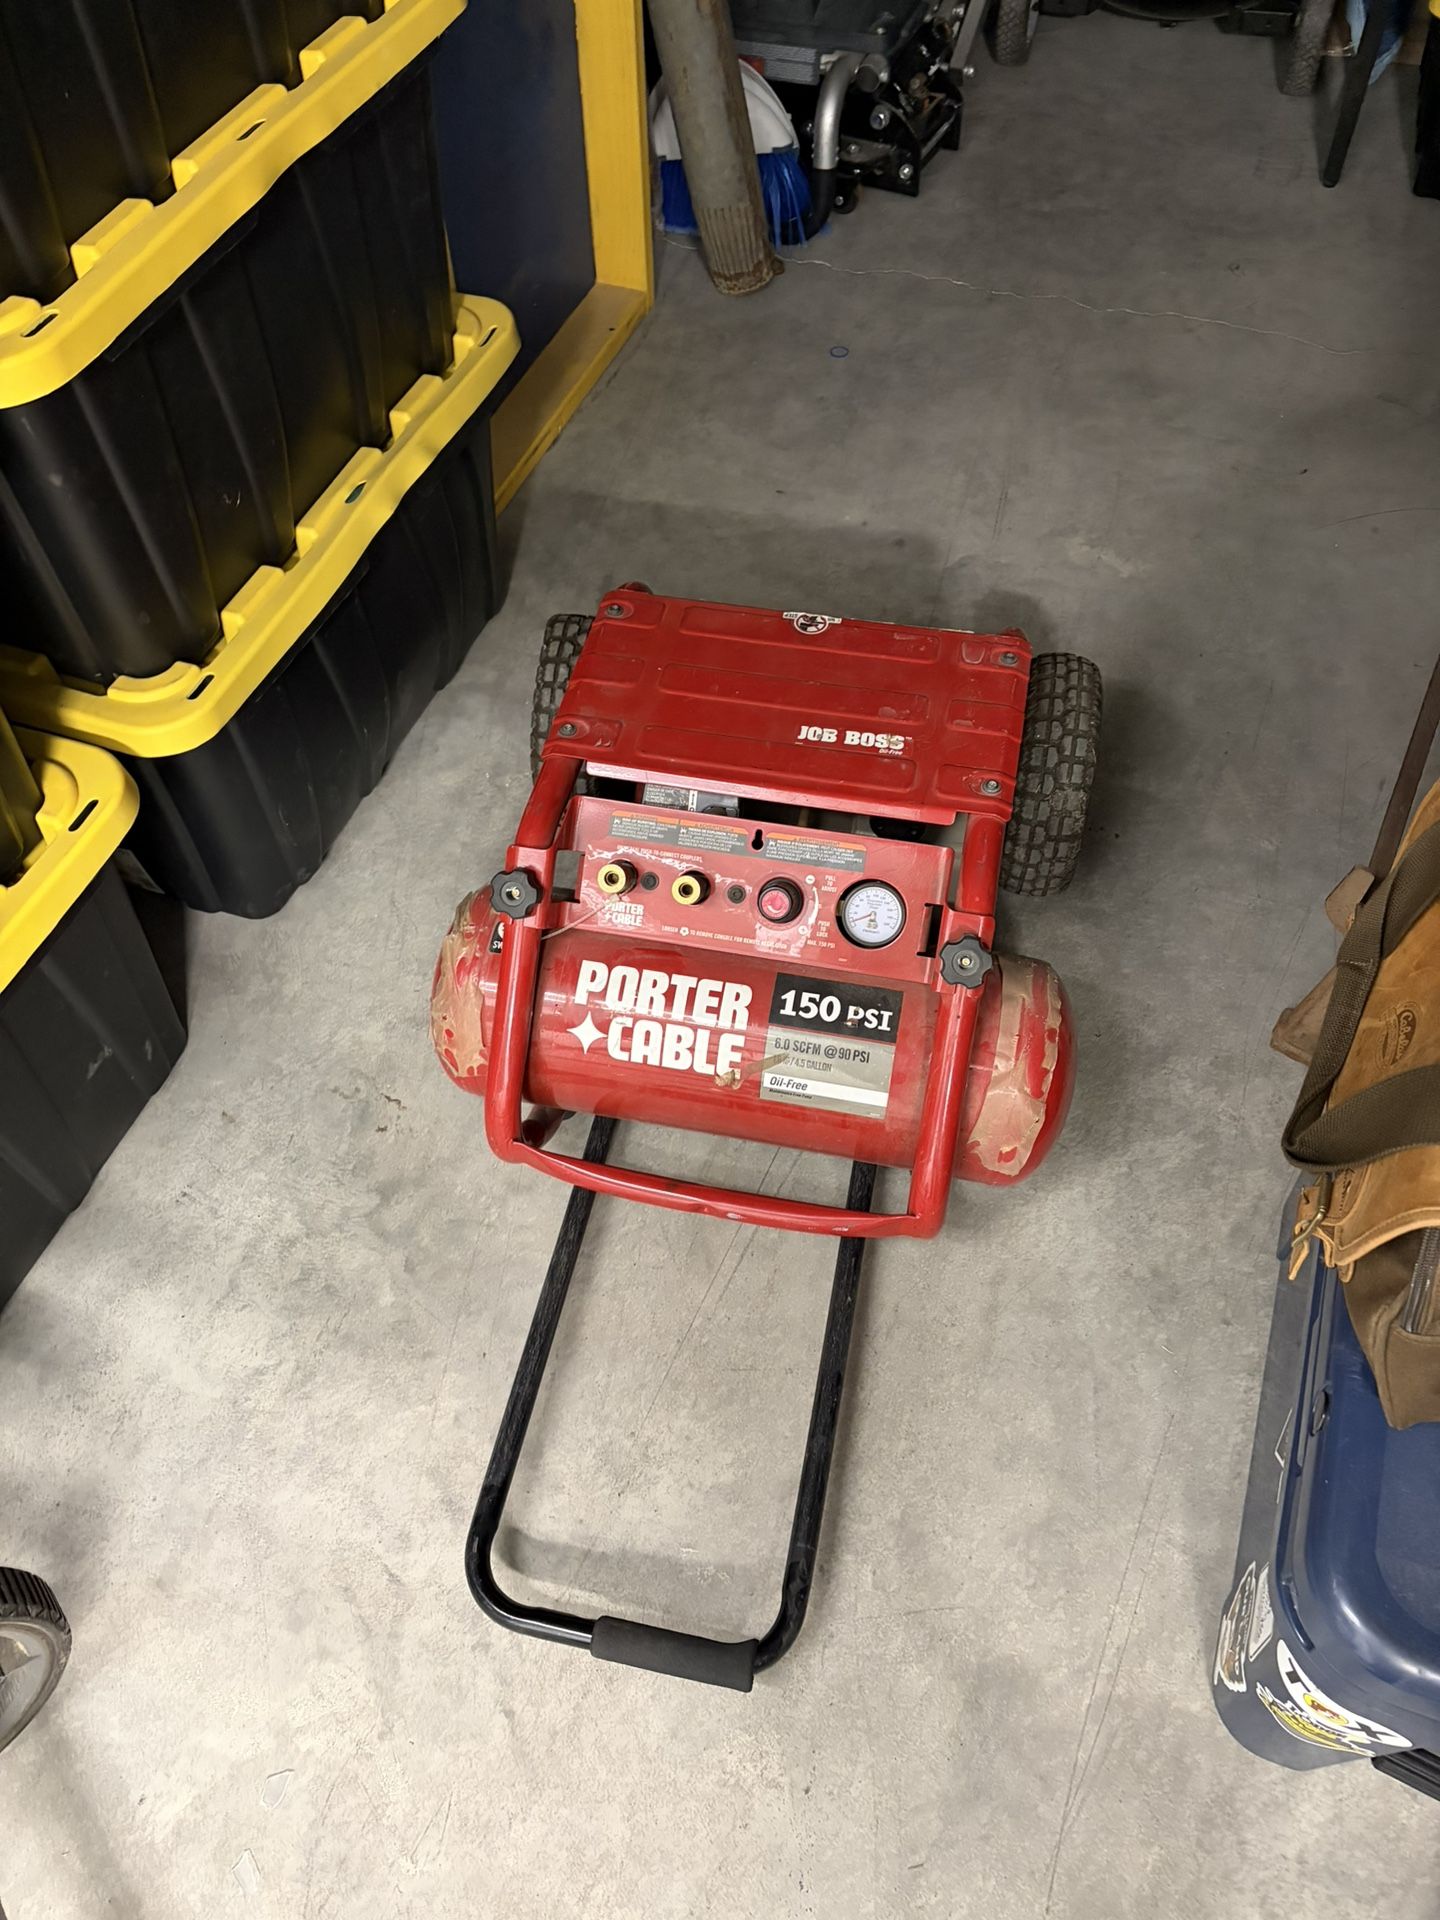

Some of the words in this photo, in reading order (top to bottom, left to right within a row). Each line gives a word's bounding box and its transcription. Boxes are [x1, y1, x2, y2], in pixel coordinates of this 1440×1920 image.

[797, 725, 838, 743] JOB
[844, 730, 905, 750] BOSS
[611, 912, 643, 927] CABLE
[574, 960, 753, 1031] PORTER
[779, 989, 842, 1023] 150
[846, 1004, 893, 1032] PSI
[607, 1016, 746, 1080] CABLE
[775, 1037, 790, 1050] 6.0
[793, 1041, 821, 1055] SCFM
[853, 1049, 870, 1063] PSI
[806, 1060, 832, 1073] GALLON
[769, 1076, 809, 1091] Oil-Free
